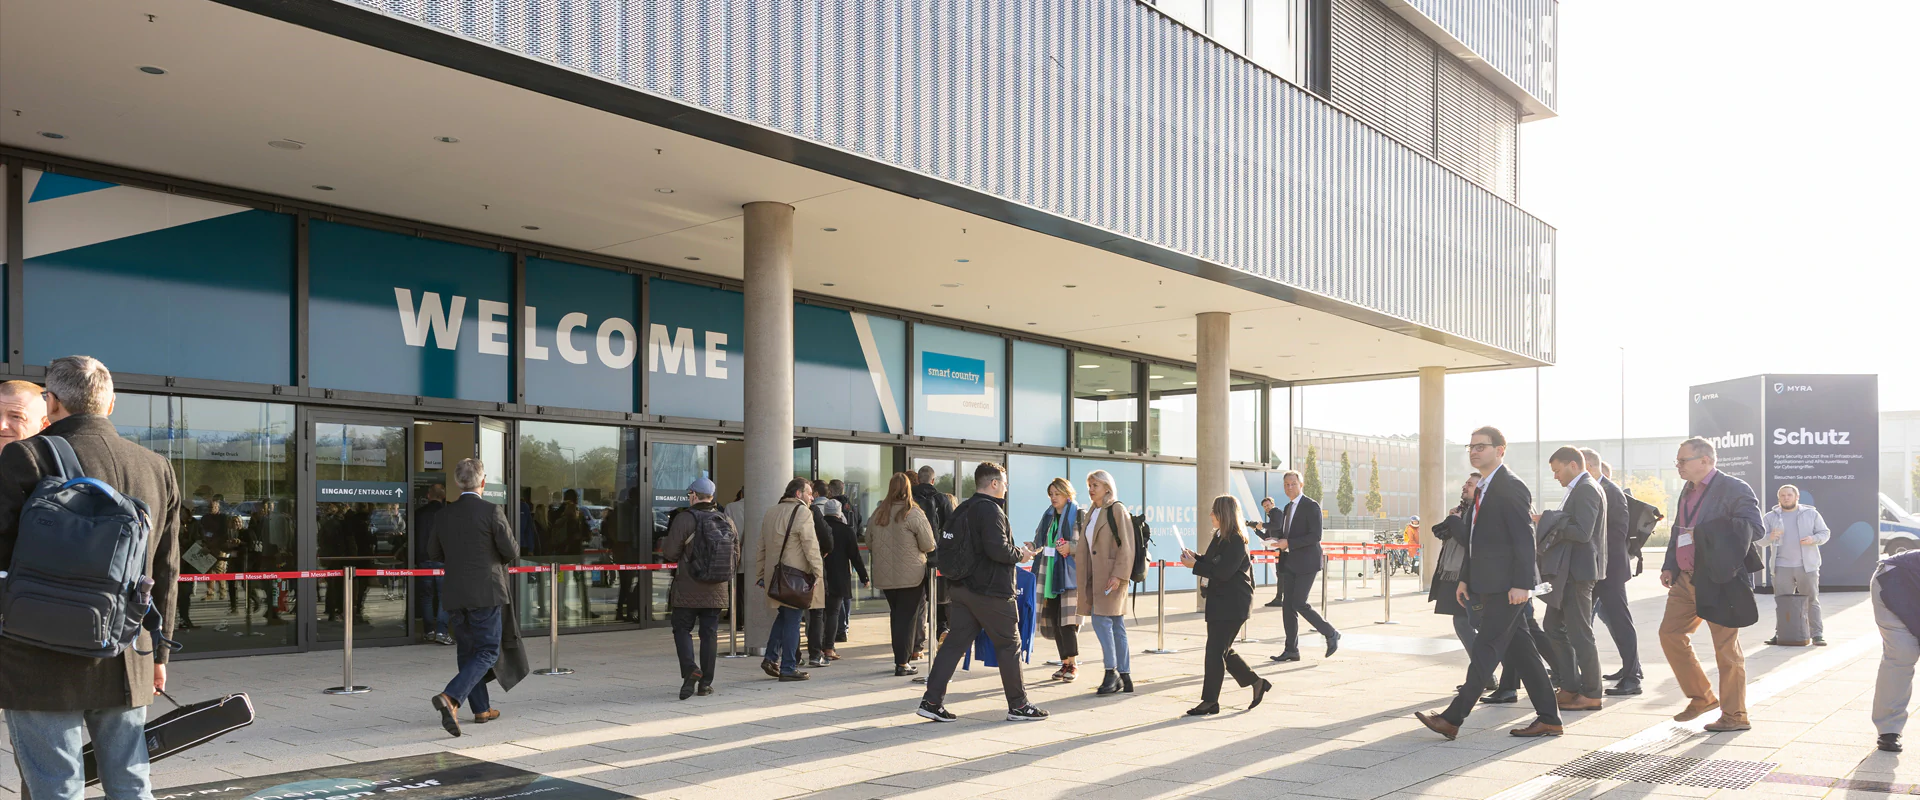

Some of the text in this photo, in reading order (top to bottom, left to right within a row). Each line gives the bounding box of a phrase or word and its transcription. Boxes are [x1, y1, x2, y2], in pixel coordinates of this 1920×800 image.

[394, 287, 728, 380] WELCOME
[928, 367, 980, 384] smart country
[1702, 392, 1718, 400] MYRA
[962, 400, 989, 410] convention
[1773, 427, 1850, 445] Schutz
